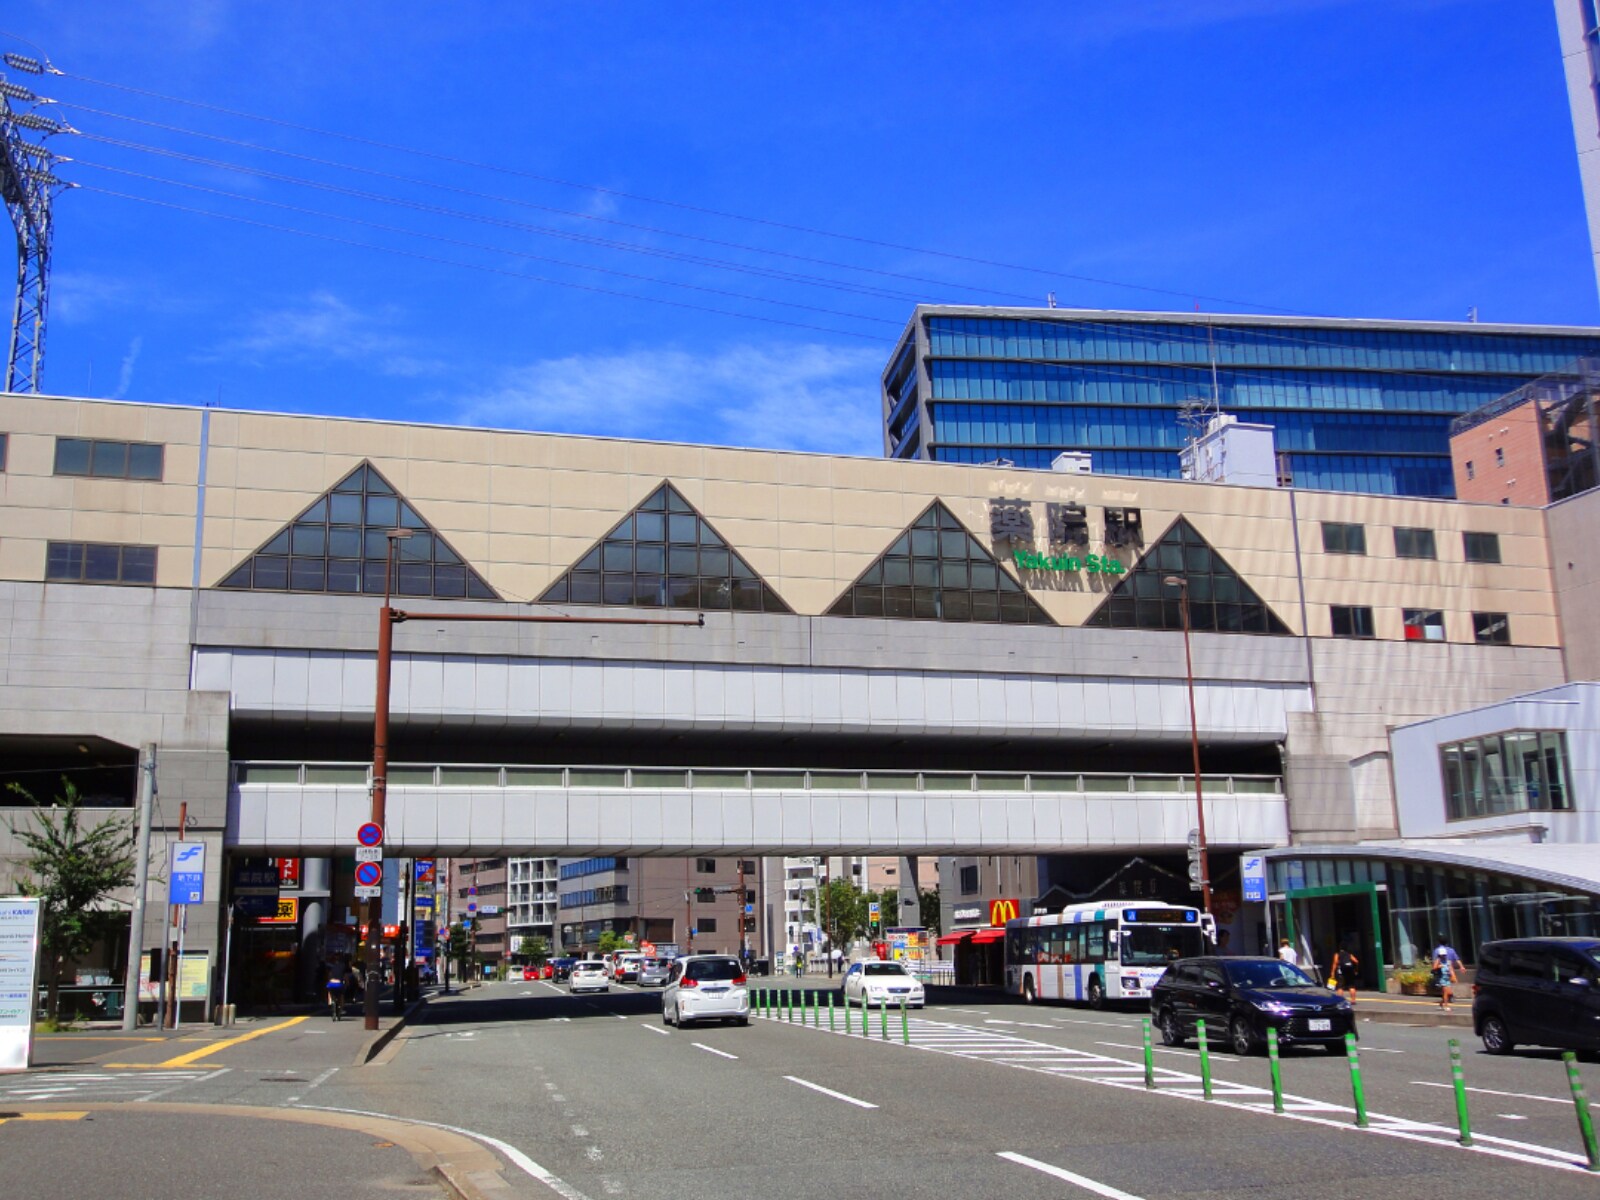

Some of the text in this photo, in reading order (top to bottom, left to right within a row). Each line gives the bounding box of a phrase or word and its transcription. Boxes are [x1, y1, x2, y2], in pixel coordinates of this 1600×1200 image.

[989, 496, 1144, 548] 薬院駅
[1013, 549, 1127, 574] Yakuin Sta.
